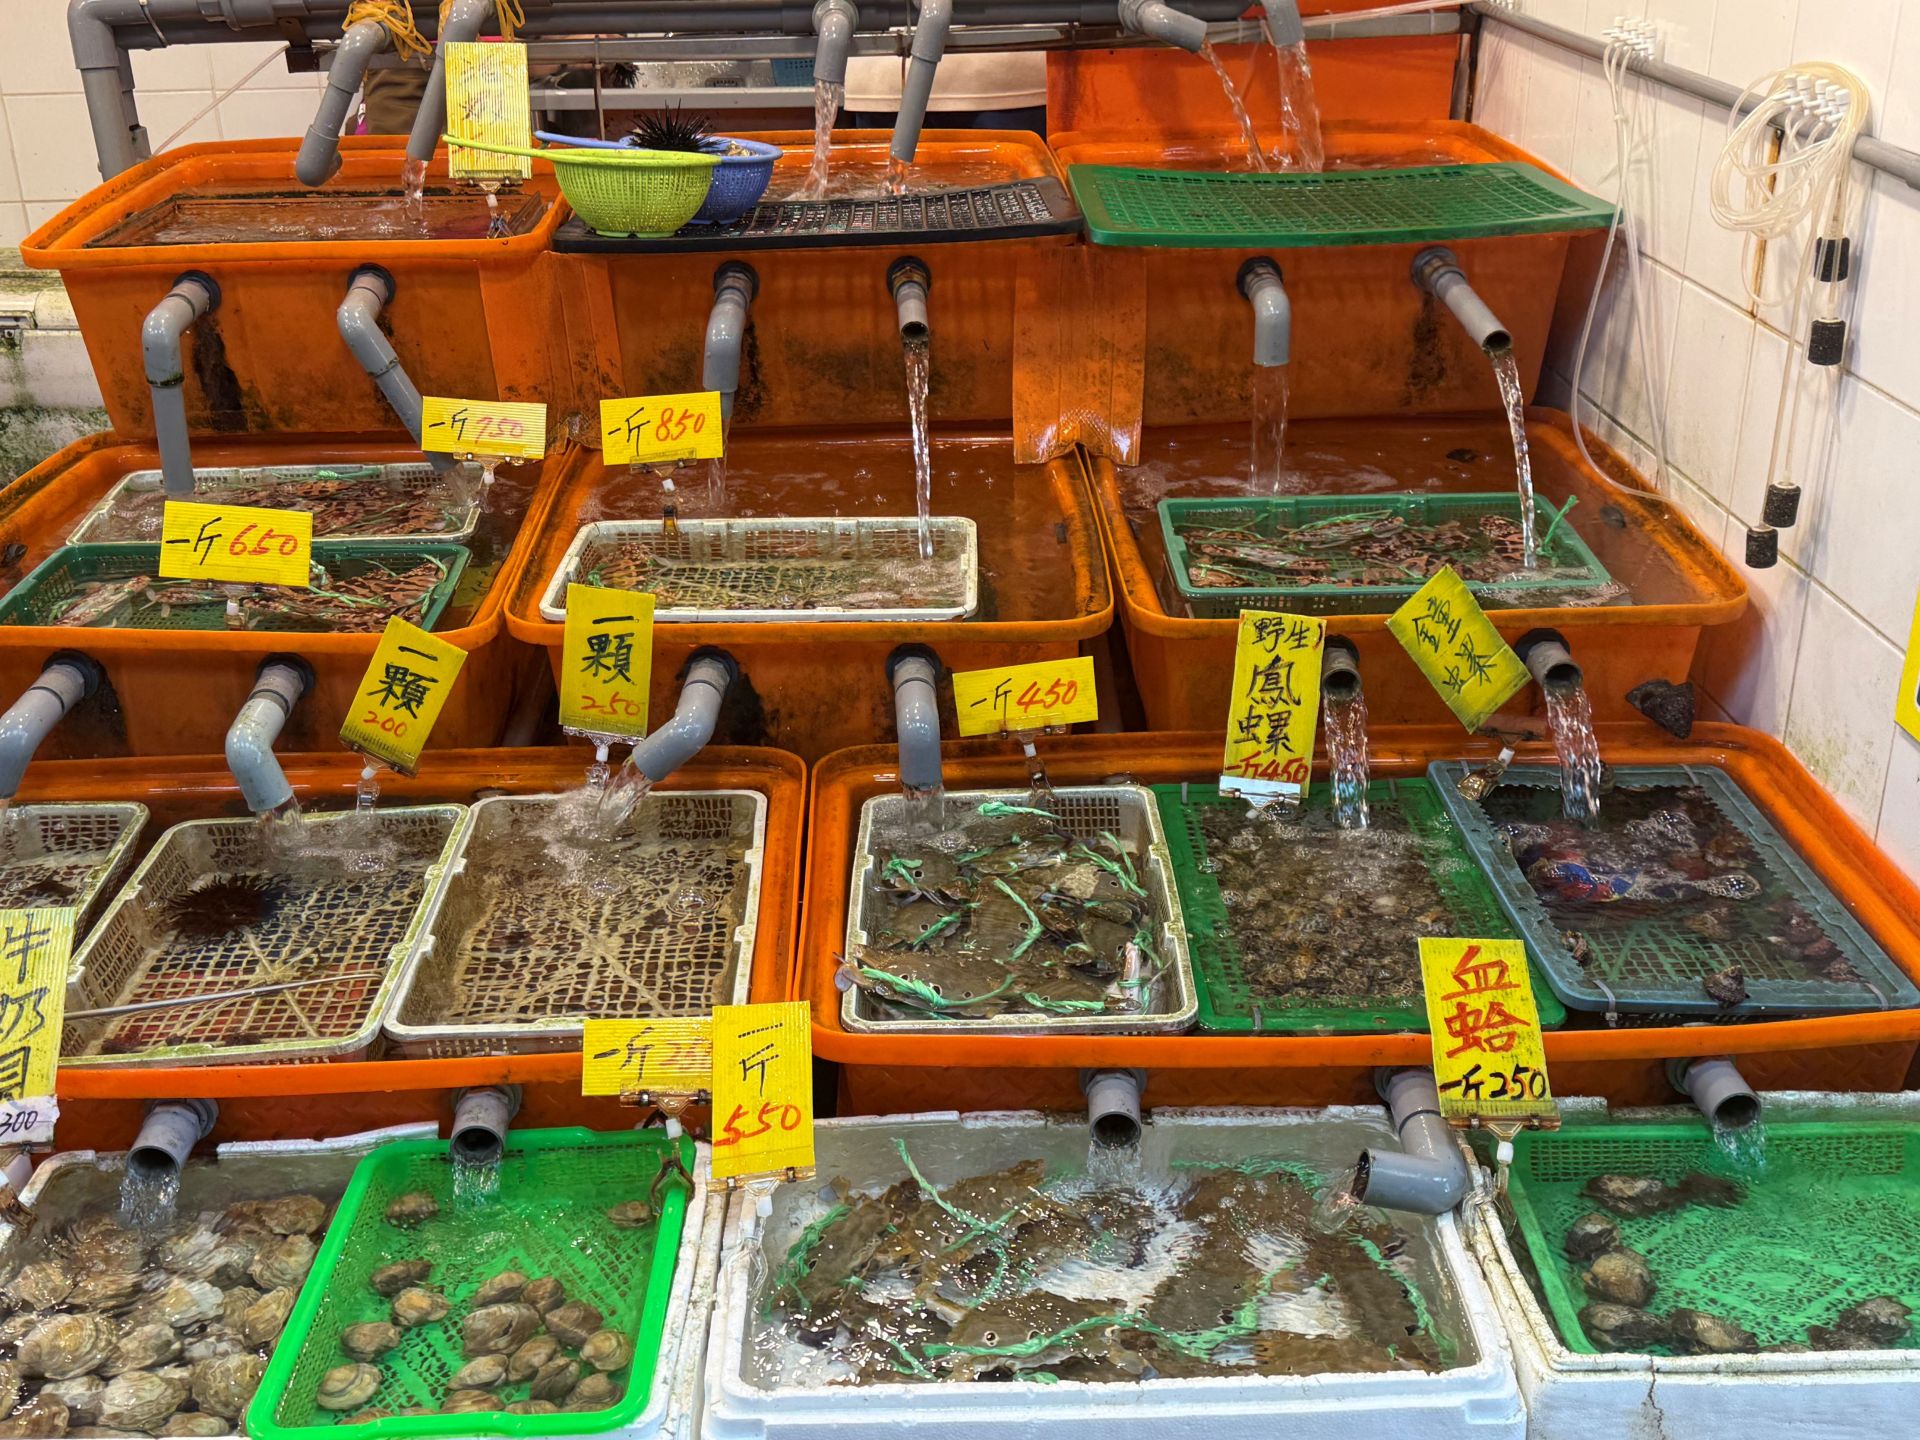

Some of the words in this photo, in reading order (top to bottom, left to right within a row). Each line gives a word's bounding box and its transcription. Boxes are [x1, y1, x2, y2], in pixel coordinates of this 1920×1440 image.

[363, 710, 408, 737] 200
[581, 692, 641, 716] 250
[1441, 945, 1531, 1059] 血蛤
[738, 1022, 783, 1098] 一斤
[713, 1102, 801, 1147] 550
